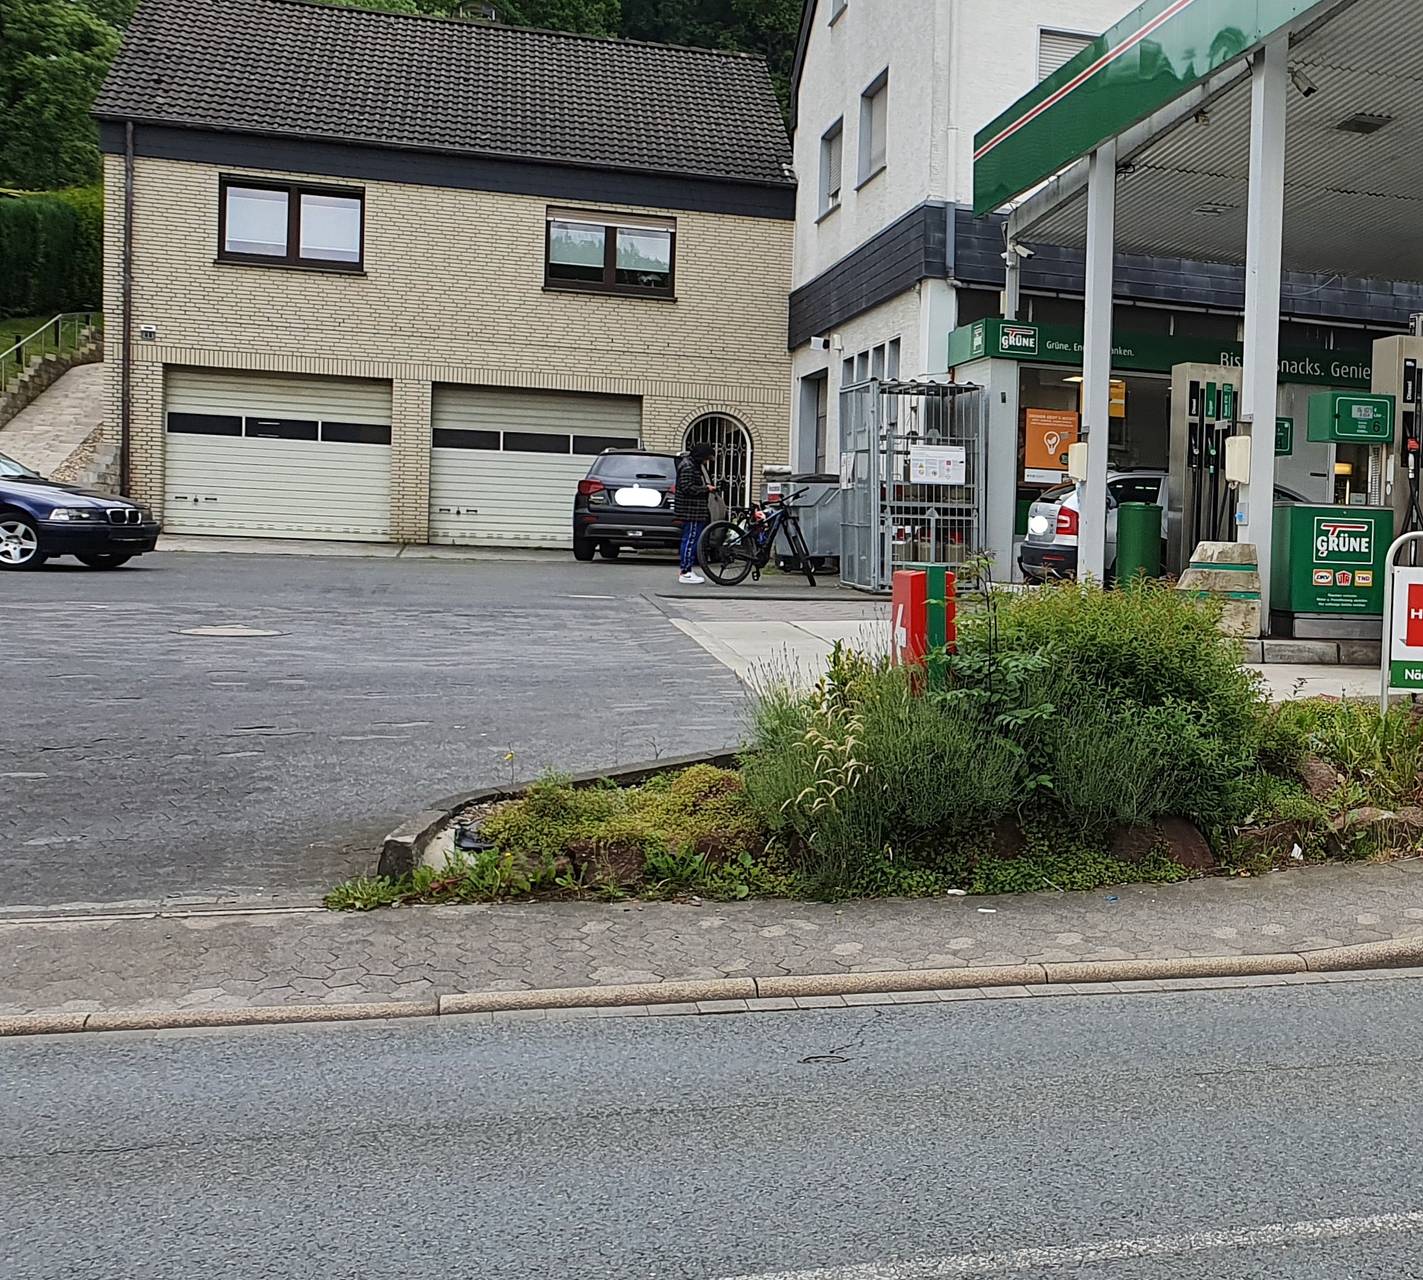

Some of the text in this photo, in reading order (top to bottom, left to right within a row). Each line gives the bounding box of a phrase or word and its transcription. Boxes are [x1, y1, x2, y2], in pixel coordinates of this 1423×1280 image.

[1001, 333, 1035, 349] GRÜNE
[1046, 340, 1071, 351] Grüne.
[1220, 352, 1371, 379] Bis nacks. Genie
[1316, 533, 1370, 556] GRÜNE
